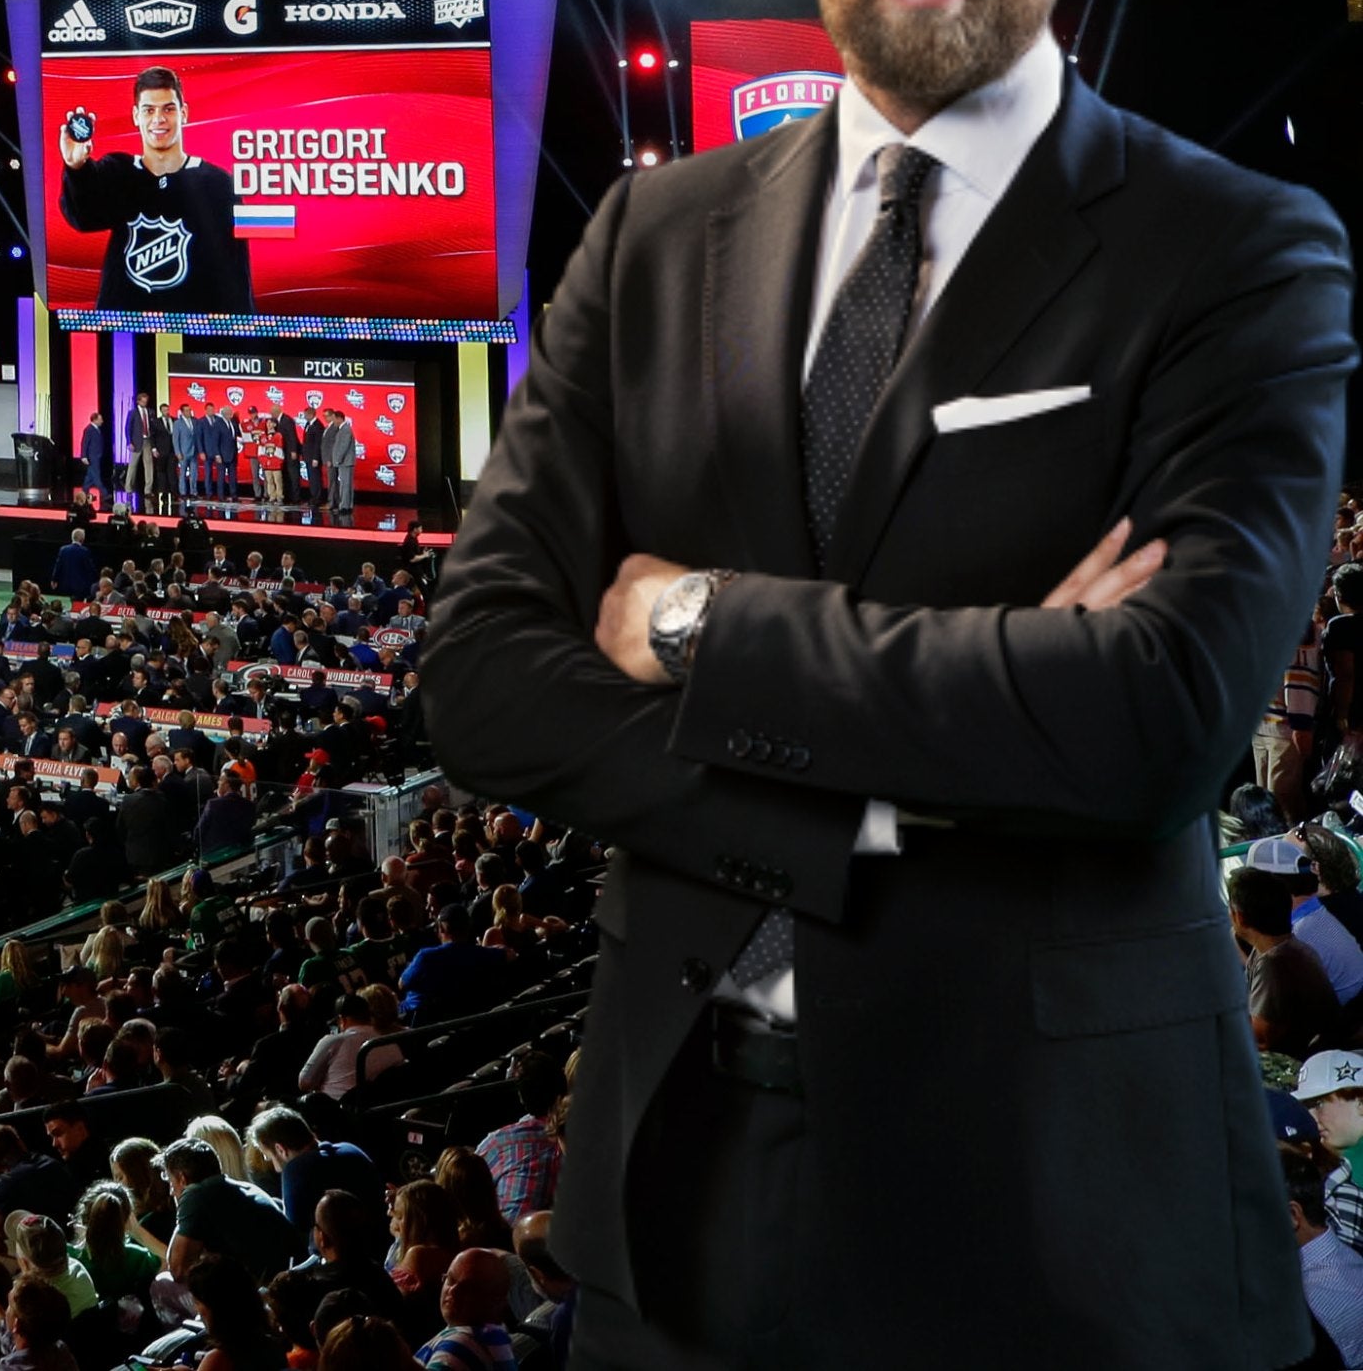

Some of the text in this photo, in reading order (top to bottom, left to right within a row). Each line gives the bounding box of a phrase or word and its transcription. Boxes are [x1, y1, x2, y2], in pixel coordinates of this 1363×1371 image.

[132, 6, 190, 26] Denny's
[285, 2, 406, 22] HONDA
[438, 7, 480, 20] DECK
[48, 26, 106, 42] adidas
[746, 83, 835, 109] FLORID
[231, 128, 386, 160] GRIGORI
[233, 161, 465, 196] DENISENKO
[136, 238, 178, 270] NHL
[209, 358, 364, 378] ROUND 1 PICK 15
